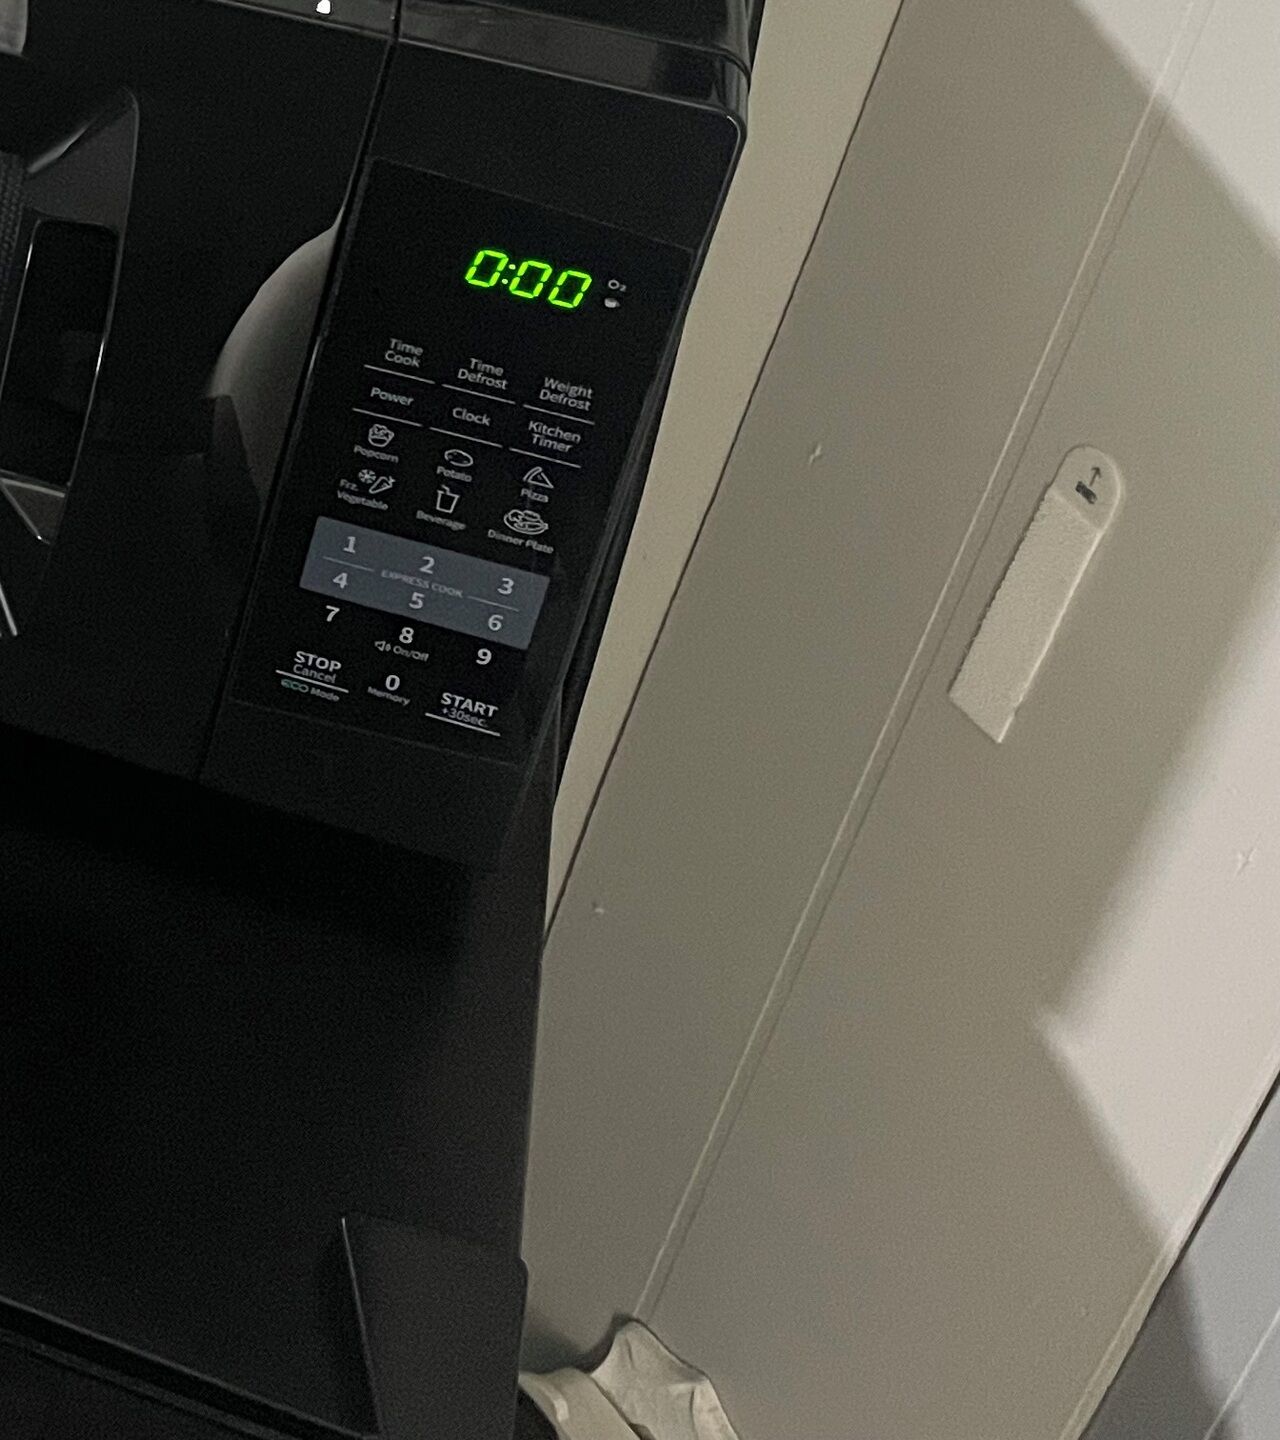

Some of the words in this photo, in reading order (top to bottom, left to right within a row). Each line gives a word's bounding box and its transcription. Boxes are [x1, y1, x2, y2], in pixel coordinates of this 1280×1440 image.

[465, 249, 592, 309] 0:00
[389, 337, 424, 357] Time
[385, 350, 421, 368] Cook
[470, 358, 505, 377] Time
[457, 368, 509, 391] Defrost
[544, 377, 593, 400] Weight
[370, 386, 414, 407] Power
[539, 389, 592, 412] Defrost
[452, 407, 491, 427] Clock
[528, 420, 582, 444] Kitchen
[532, 434, 574, 453] Timer
[353, 444, 399, 464] Popcorn
[436, 466, 473, 483] Potato
[337, 490, 389, 511] Vegetable
[520, 487, 549, 504] Pizza
[416, 510, 467, 532] Beverage
[342, 535, 357, 554] 1
[487, 528, 524, 548] Dinner
[525, 539, 555, 555] Plate
[419, 556, 436, 574] 2
[332, 571, 349, 589] 4
[380, 569, 430, 590] EXPRESS
[431, 581, 464, 599] COOK
[497, 577, 515, 595] 3
[409, 591, 425, 610] 5
[325, 605, 341, 622] 7
[487, 614, 504, 632] 6
[398, 626, 415, 644] 8
[293, 650, 342, 672] STOP
[392, 644, 429, 662] On/Off
[475, 648, 492, 666] 9
[292, 664, 337, 684] Cancel
[384, 674, 401, 691] 0
[310, 686, 340, 703] Mode
[367, 686, 411, 706] Memory
[440, 691, 499, 718] START
